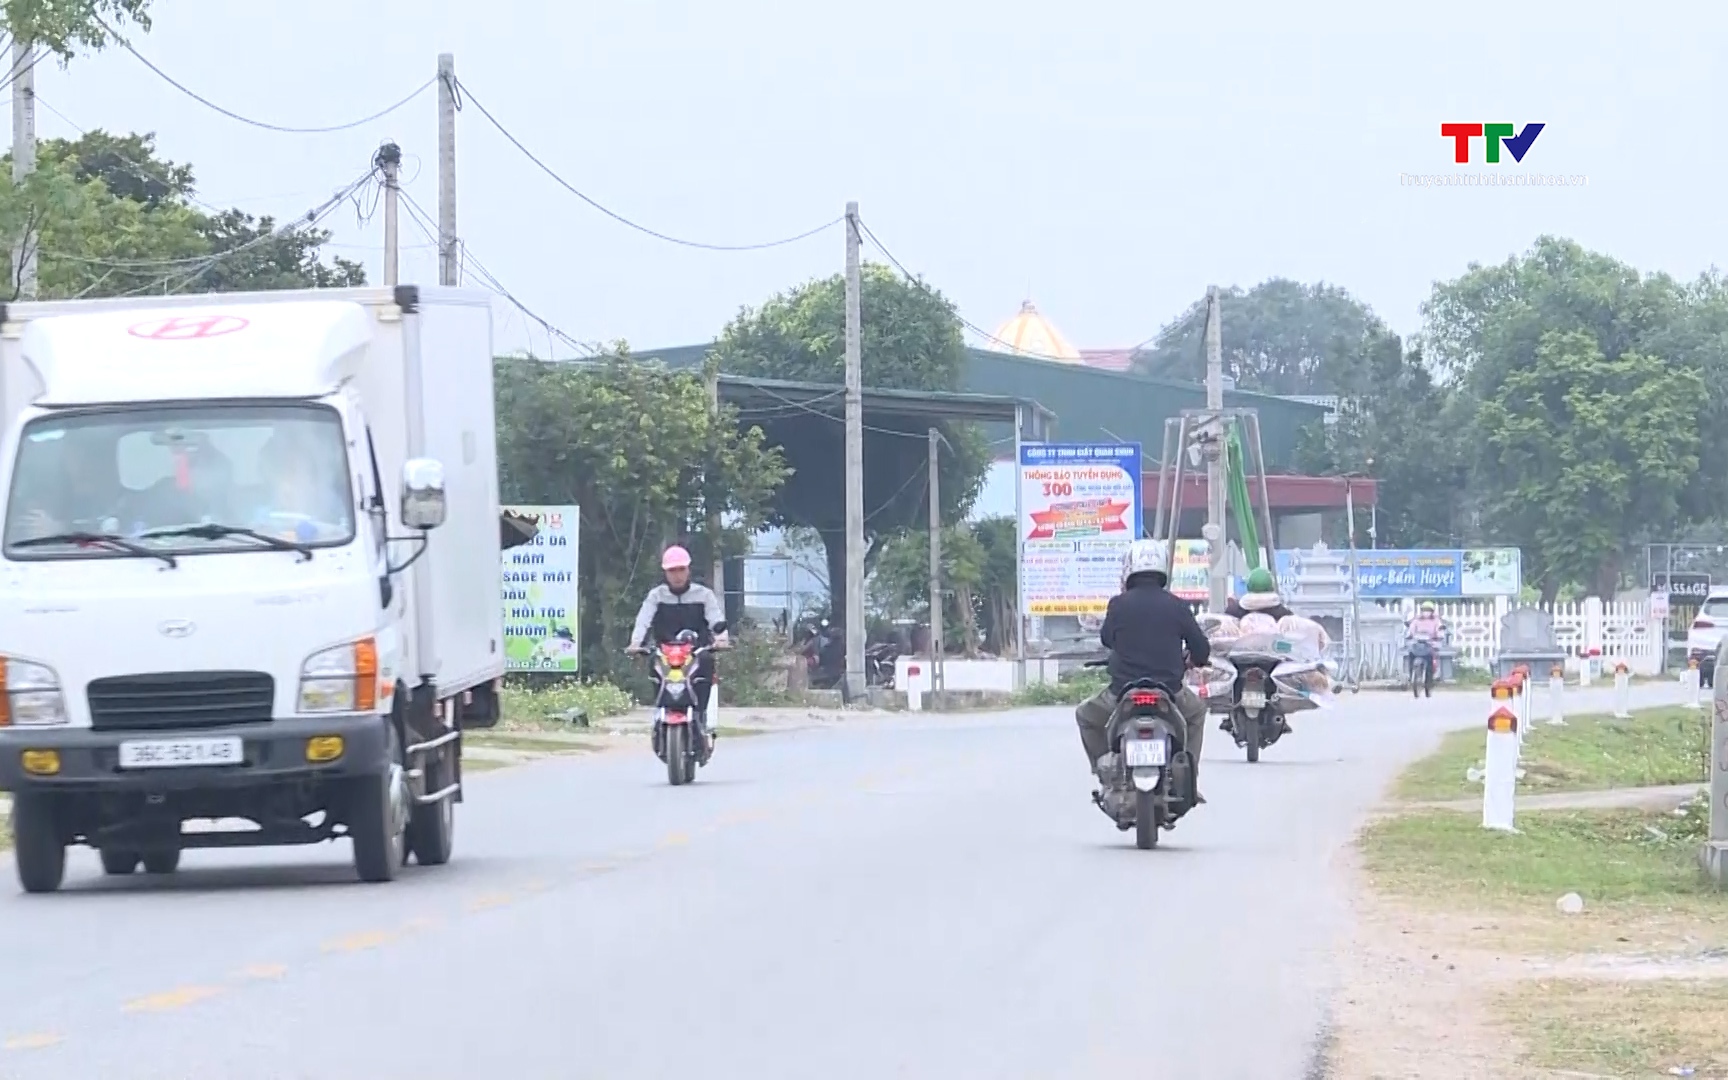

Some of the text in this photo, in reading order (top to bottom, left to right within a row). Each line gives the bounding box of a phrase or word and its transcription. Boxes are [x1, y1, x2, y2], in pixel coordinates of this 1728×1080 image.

[1024, 469, 1052, 480] THÔNG
[1053, 469, 1071, 480] BÁO
[1042, 482, 1072, 496] 300
